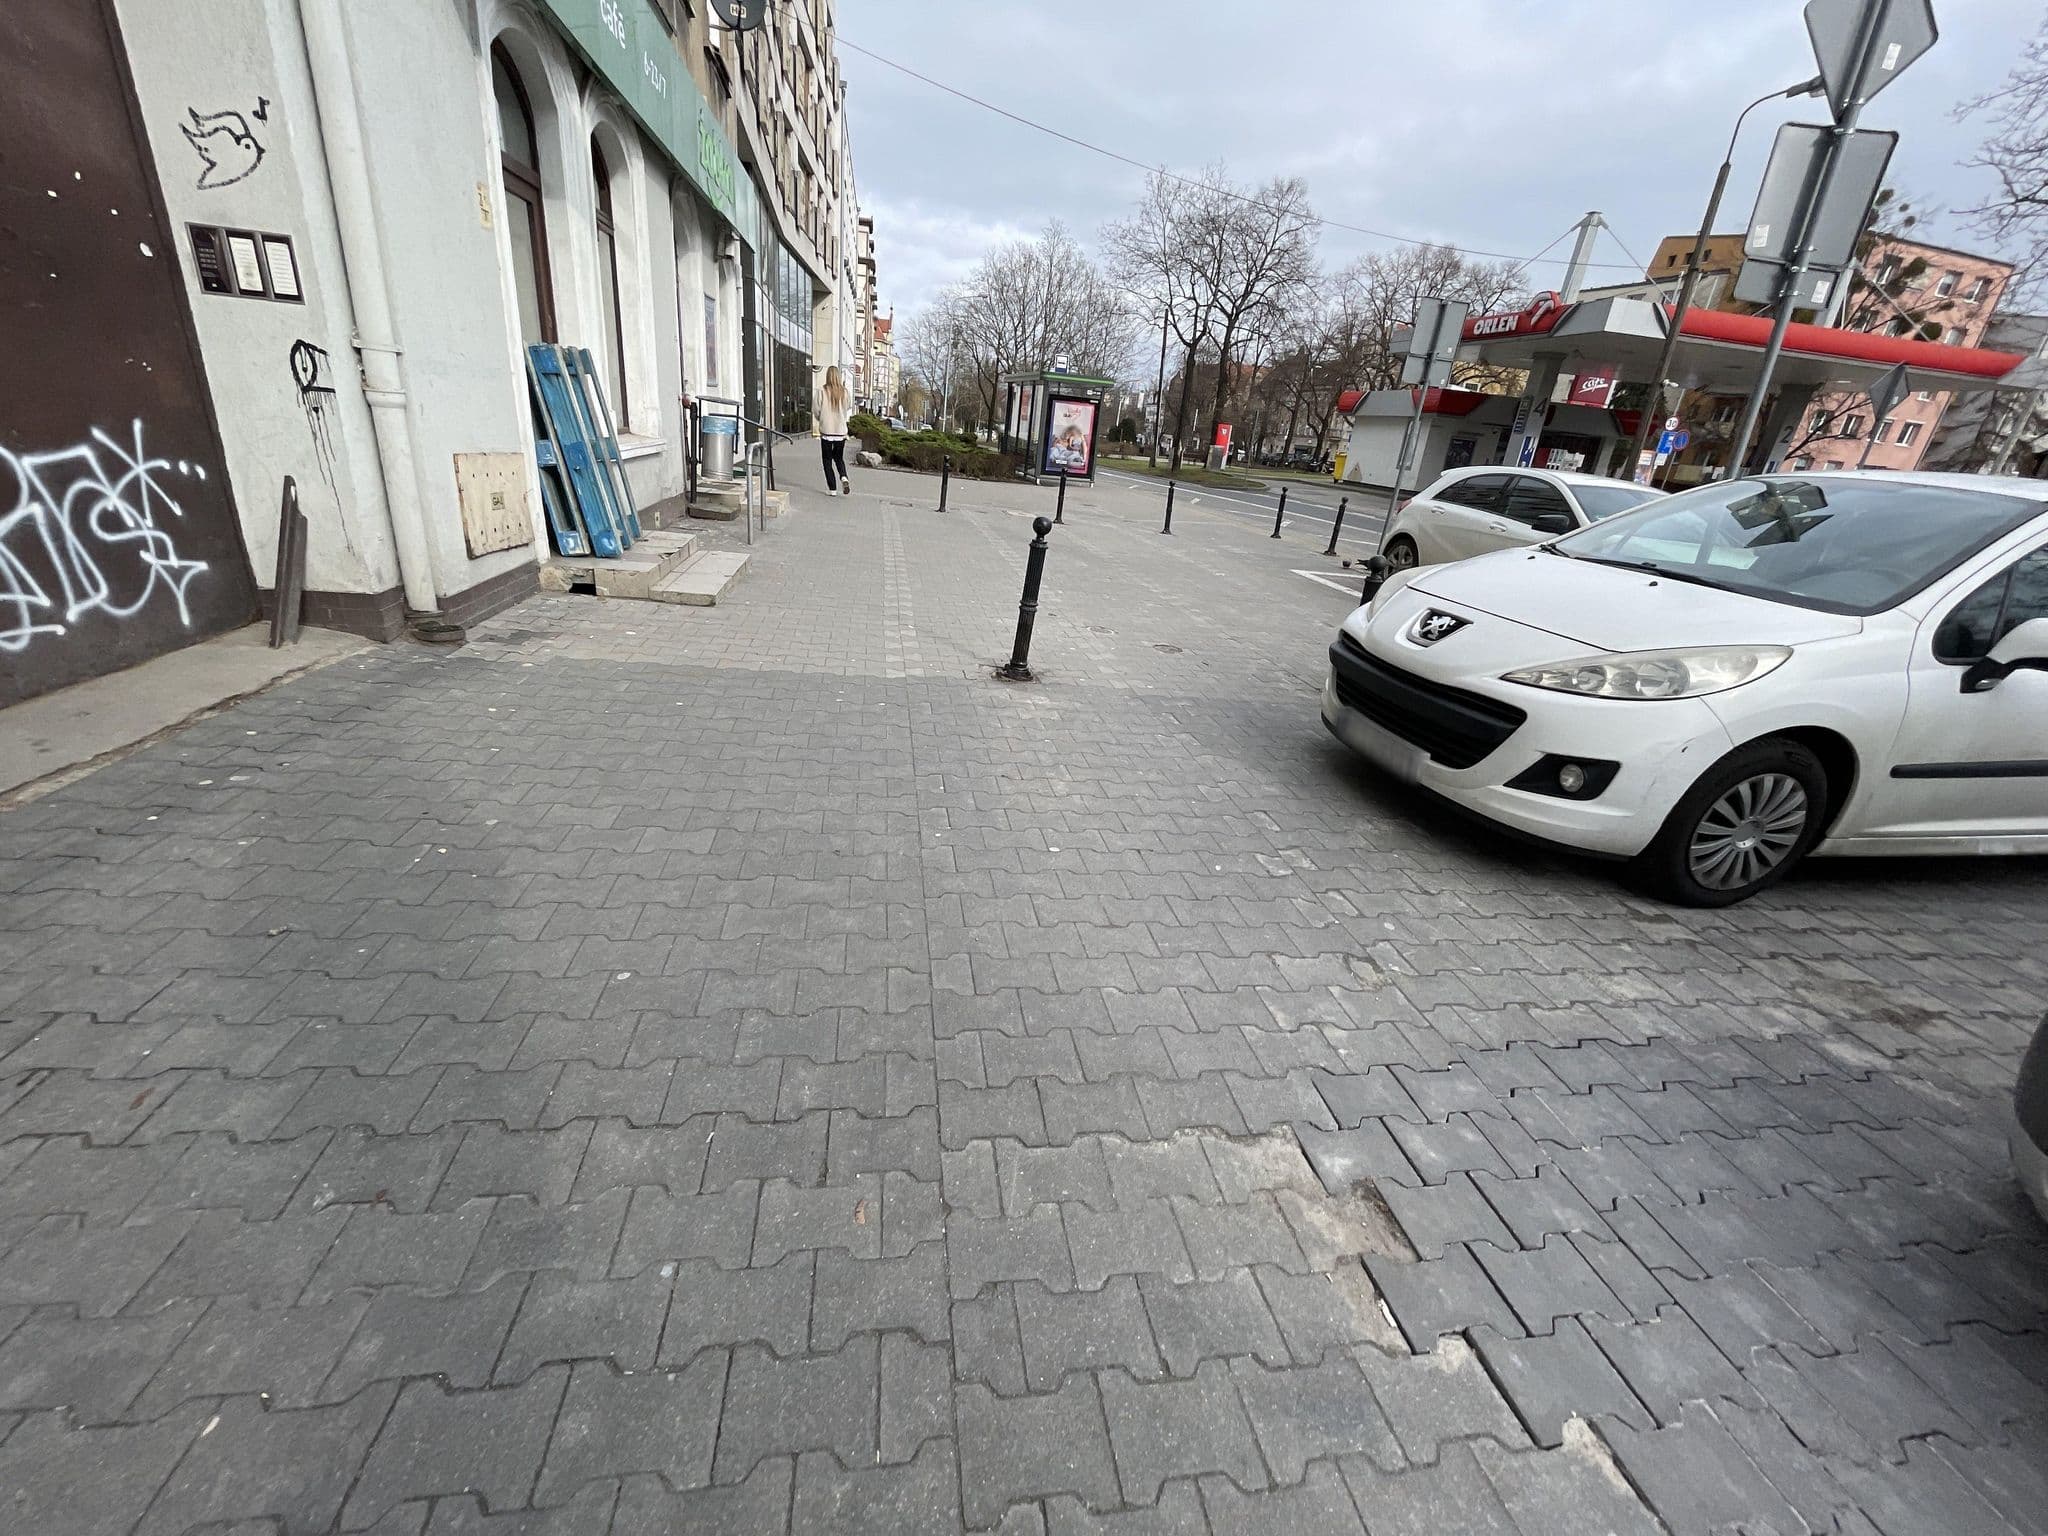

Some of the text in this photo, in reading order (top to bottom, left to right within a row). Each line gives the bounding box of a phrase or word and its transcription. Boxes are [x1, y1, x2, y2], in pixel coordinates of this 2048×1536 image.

[1473, 315, 1519, 335] ORLEN
[1533, 398, 1547, 416] 4
[1781, 425, 1794, 443] 2
